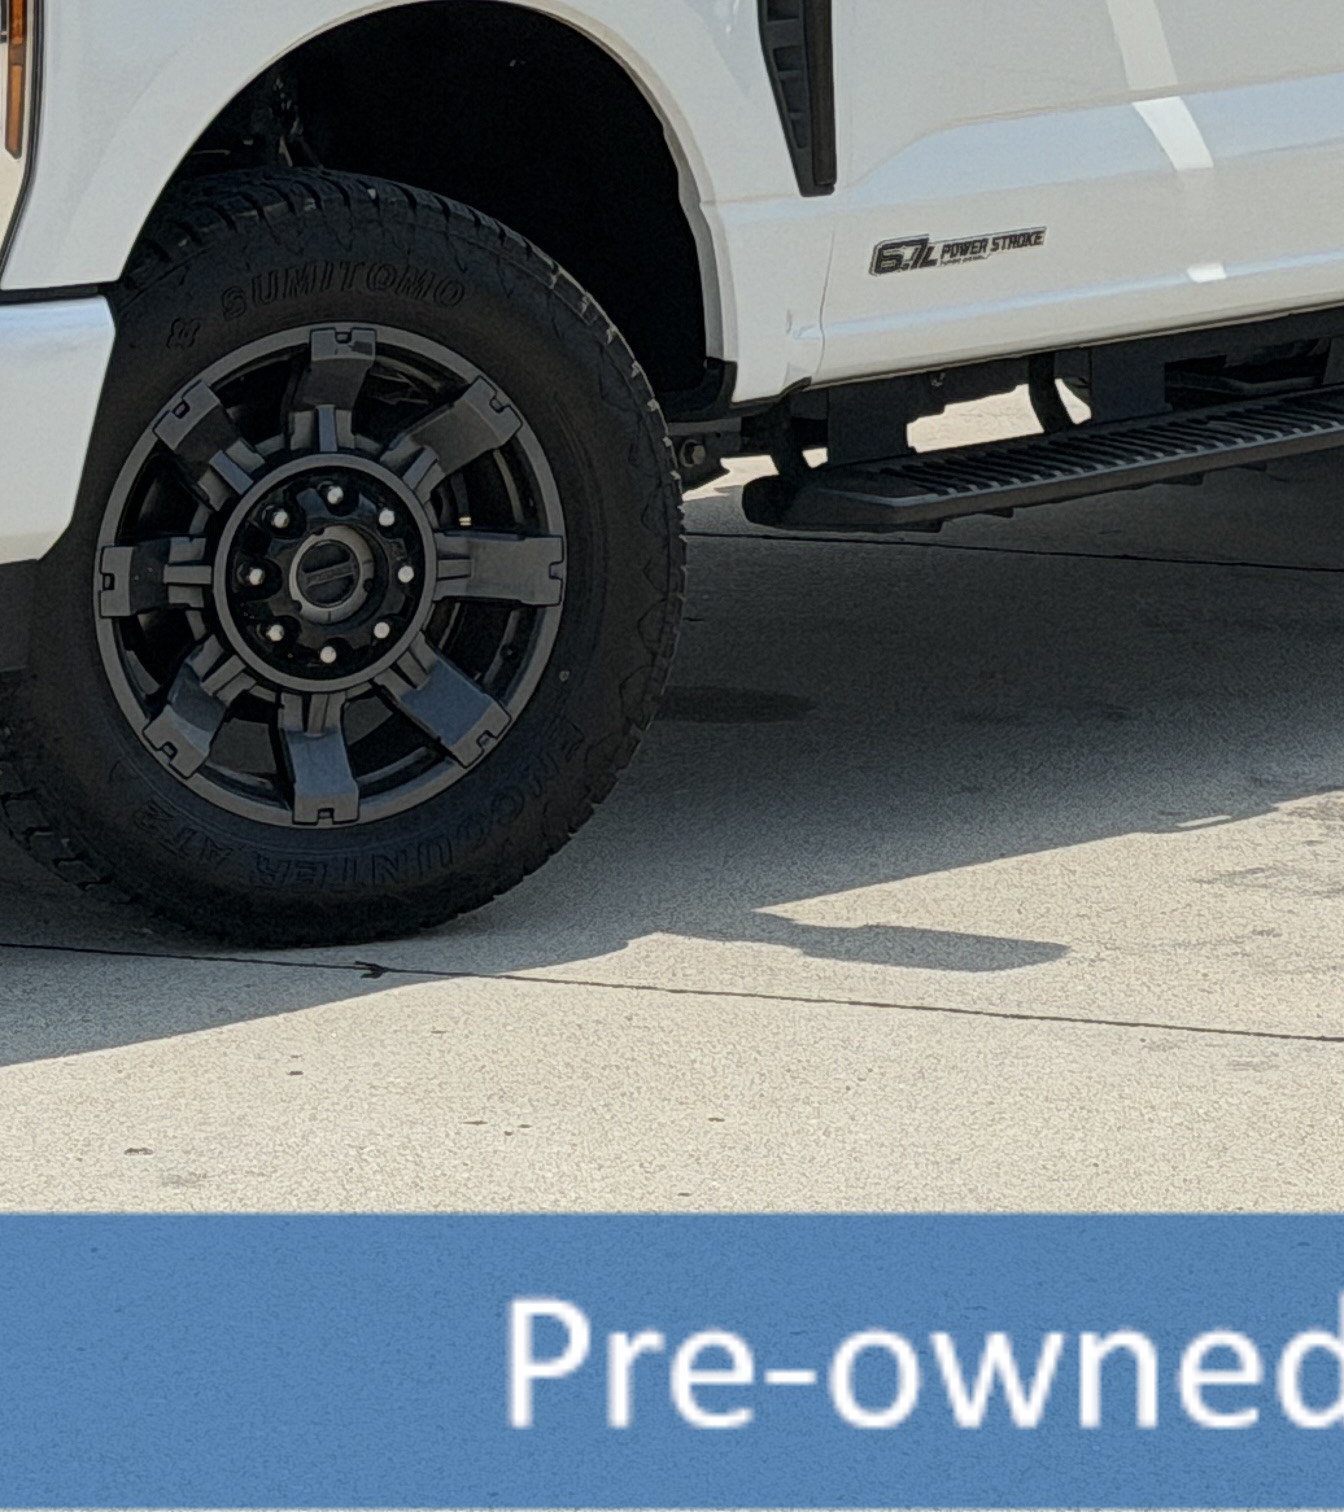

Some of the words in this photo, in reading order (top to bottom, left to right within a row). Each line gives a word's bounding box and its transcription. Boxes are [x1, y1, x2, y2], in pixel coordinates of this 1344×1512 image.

[870, 234, 938, 275] 6.7L
[940, 238, 989, 260] POWER
[990, 230, 1046, 252] STROKE
[219, 259, 467, 320] SUMITOMO
